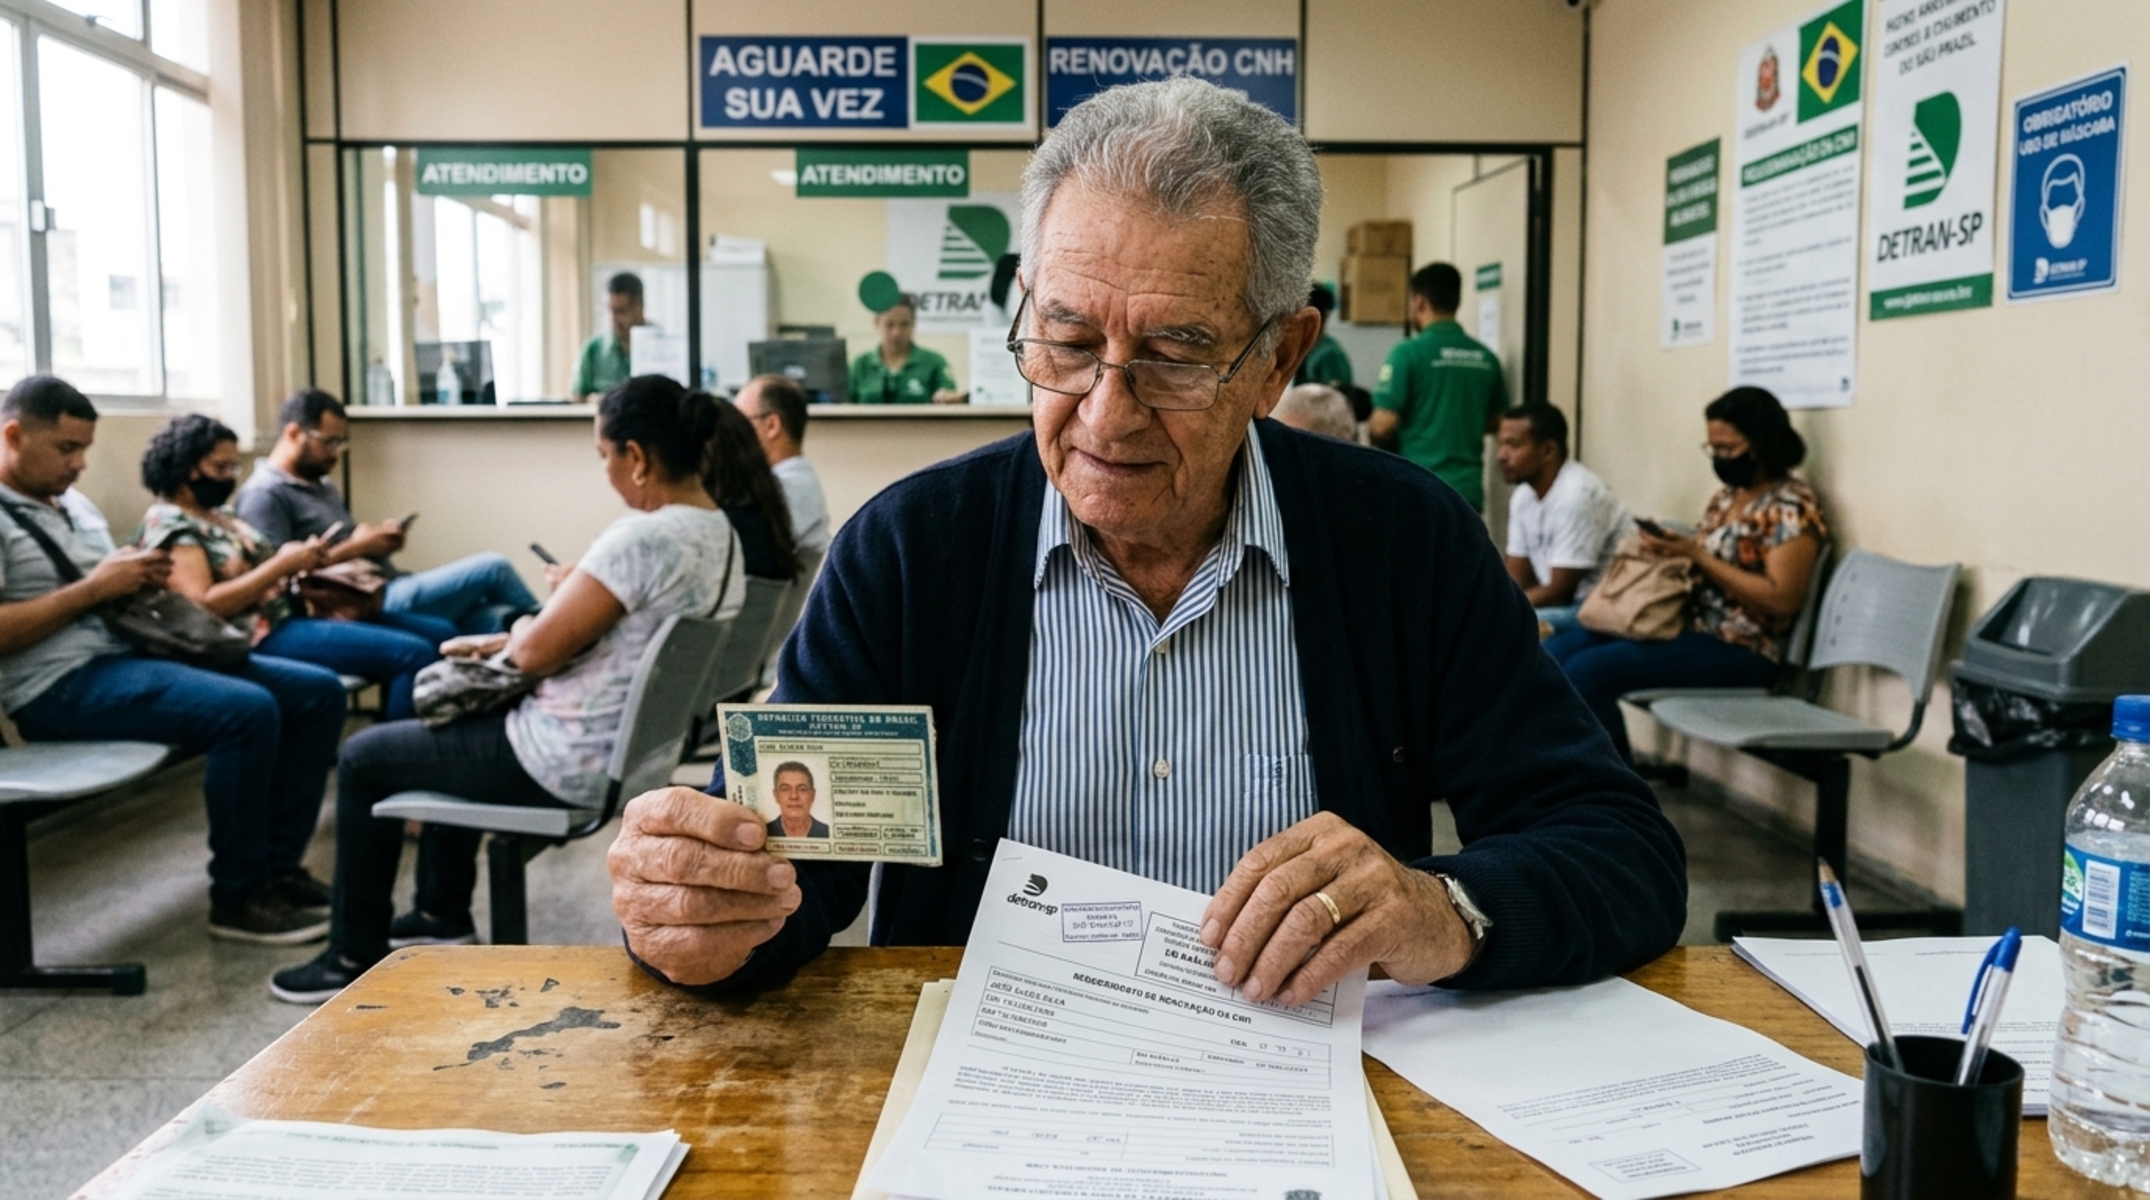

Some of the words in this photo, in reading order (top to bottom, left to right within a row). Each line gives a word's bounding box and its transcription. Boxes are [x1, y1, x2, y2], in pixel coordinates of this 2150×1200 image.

[709, 45, 897, 77] AGUARDE
[1050, 43, 1228, 75] RENOVAÇÃO
[1234, 48, 1294, 75] CNH
[724, 87, 804, 119] SUA
[810, 88, 885, 119] VEZ
[422, 162, 588, 185] ATENDIMENTO
[802, 164, 965, 186] ATENDIMENTO
[1877, 211, 1983, 262] DETRAN-SP
